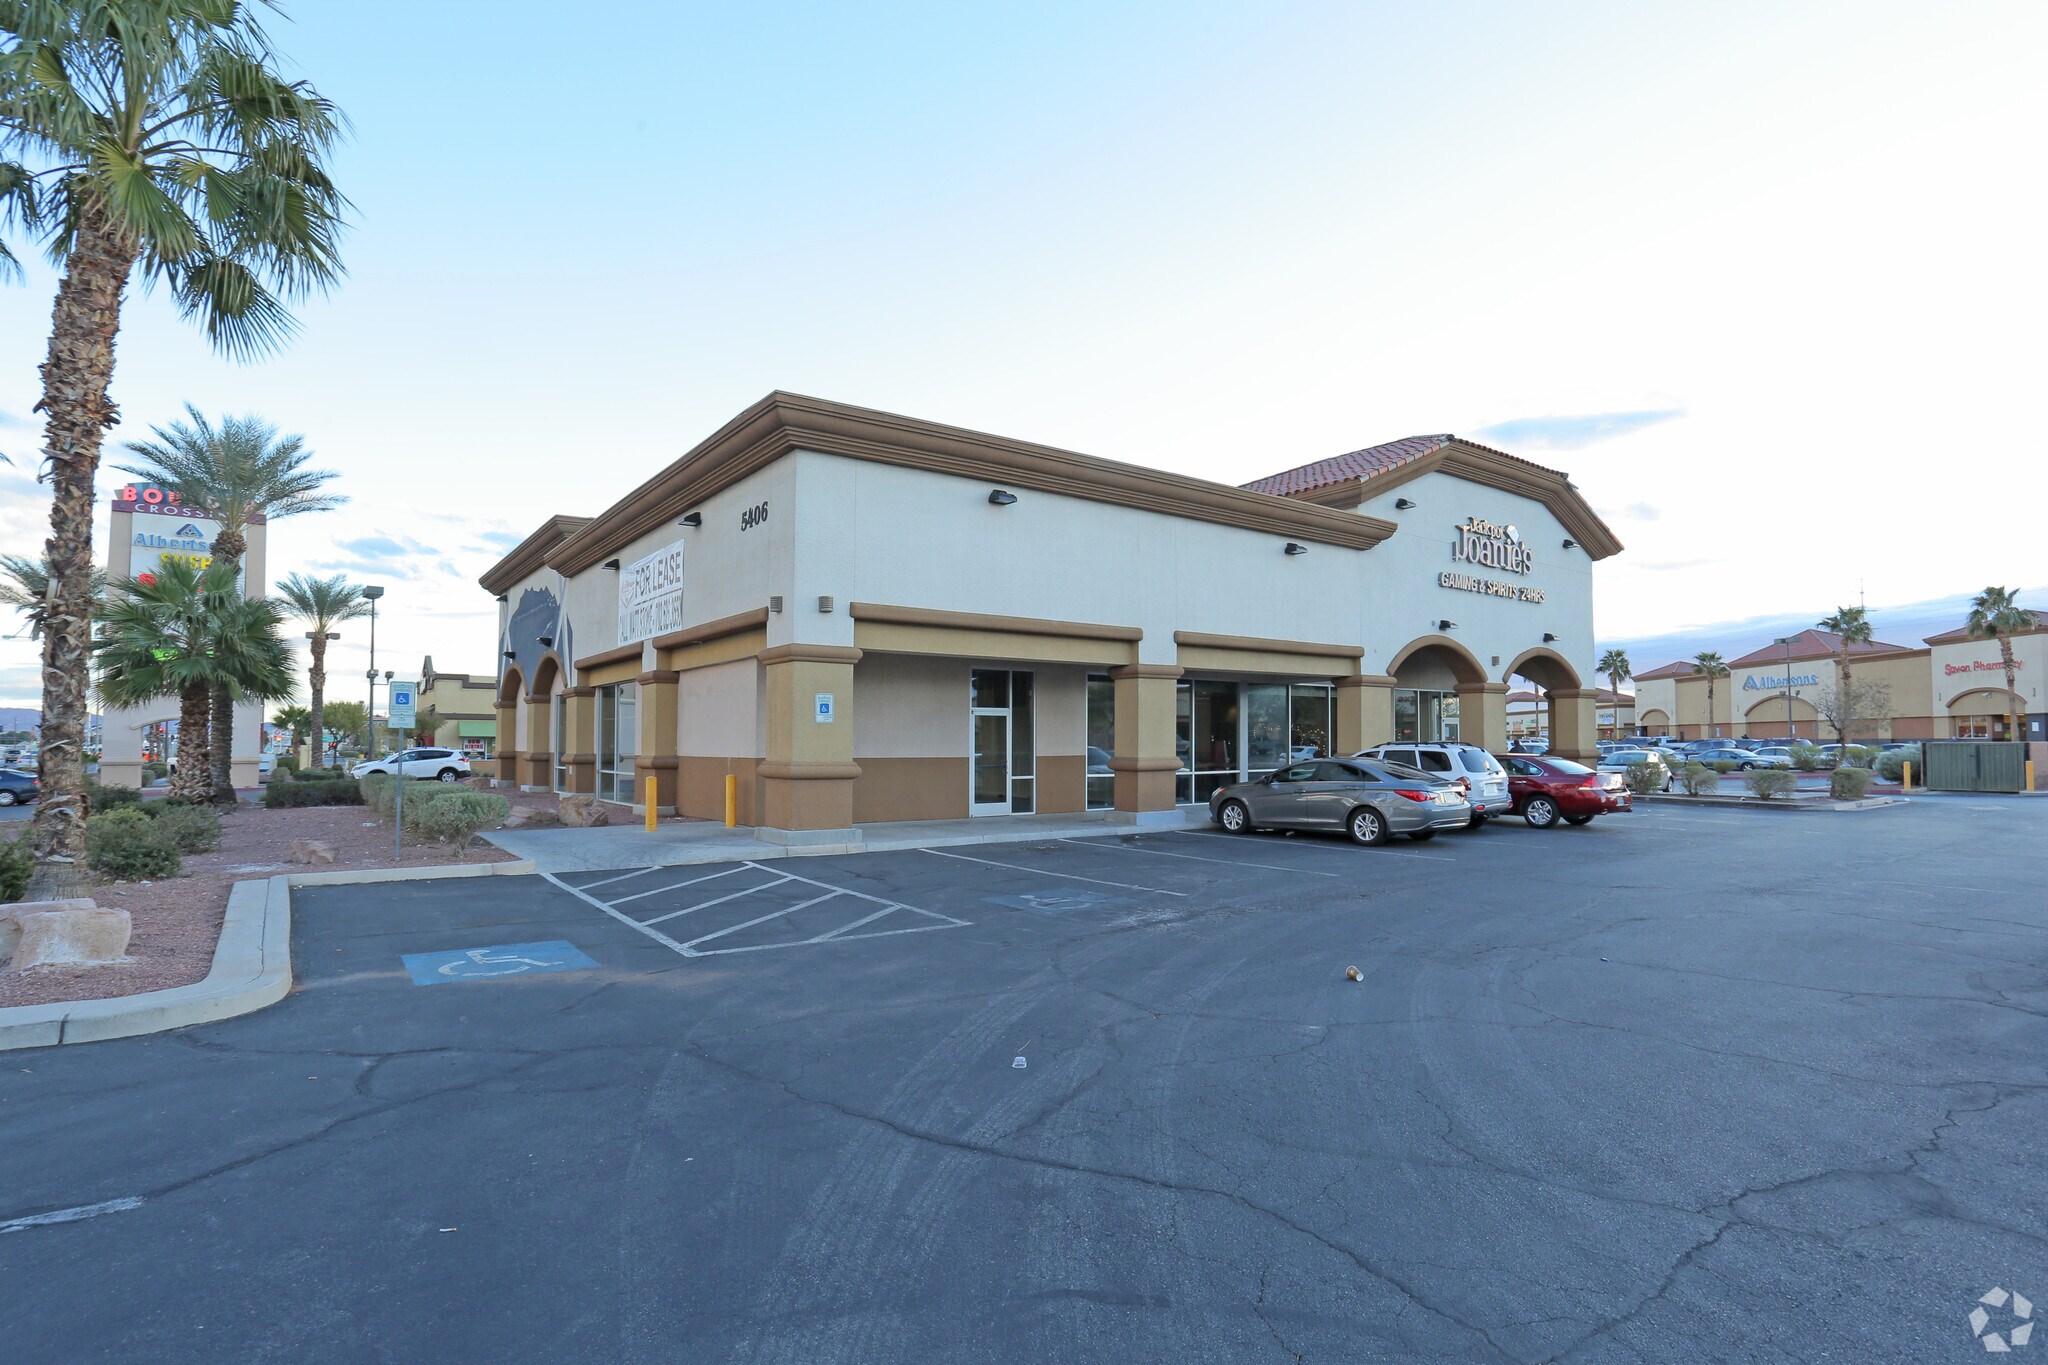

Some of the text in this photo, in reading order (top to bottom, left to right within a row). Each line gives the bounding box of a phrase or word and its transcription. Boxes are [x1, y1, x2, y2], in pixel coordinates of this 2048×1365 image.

[741, 501, 768, 531] 5406
[1468, 516, 1504, 539] Jackpot
[1453, 524, 1533, 575] Joanie's
[635, 565, 651, 598] FOR
[652, 550, 681, 591] LEASE
[1440, 571, 1546, 604] GAMING & SPIRITS 24HRS
[1973, 660, 2022, 671] Pharmcy
